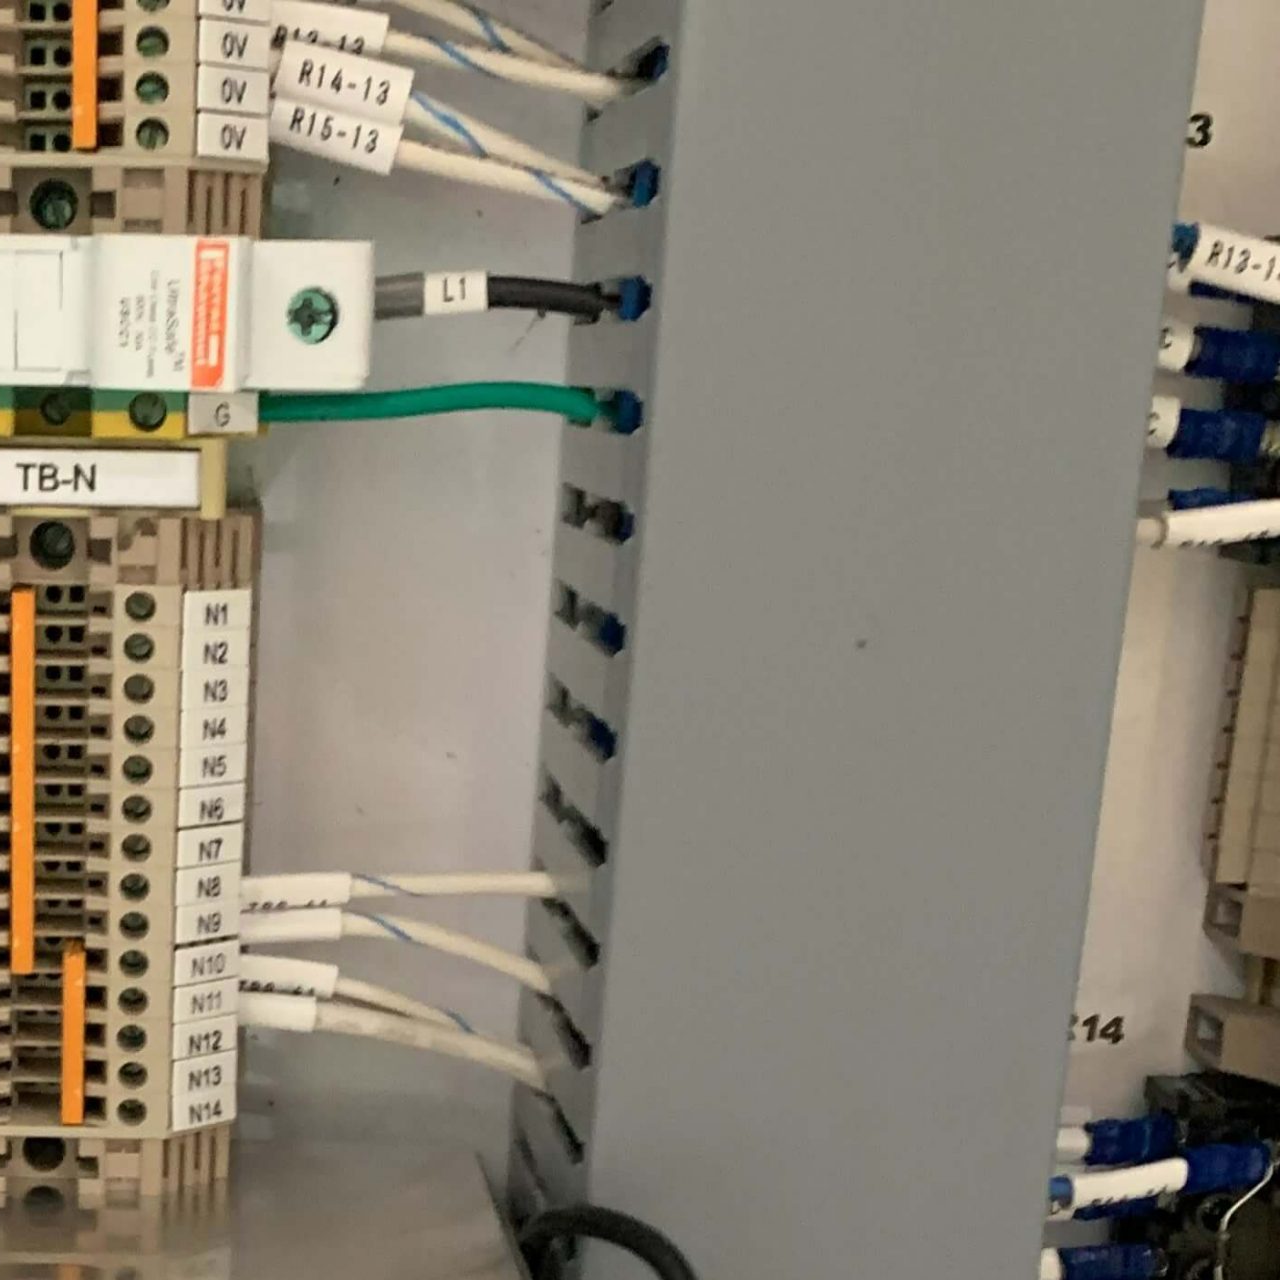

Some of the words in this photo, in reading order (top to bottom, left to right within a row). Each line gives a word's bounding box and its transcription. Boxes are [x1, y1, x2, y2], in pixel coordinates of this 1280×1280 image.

[297, 59, 391, 106] R14-13
[288, 106, 380, 154] R15-13
[441, 276, 468, 303] L1
[214, 402, 231, 427] G
[15, 463, 98, 494] TB-N
[204, 603, 229, 626] N1
[202, 642, 229, 665] N2
[203, 679, 229, 703] N3
[202, 717, 227, 741] N4
[202, 754, 227, 778] N5
[199, 797, 225, 822] N6
[198, 838, 224, 862] N7
[196, 875, 222, 899] N8
[196, 912, 222, 935] N9
[191, 953, 227, 977] N10
[191, 990, 222, 1015] N11
[188, 1029, 223, 1055] N12
[188, 1065, 223, 1091] N13
[188, 1099, 223, 1125] N14
